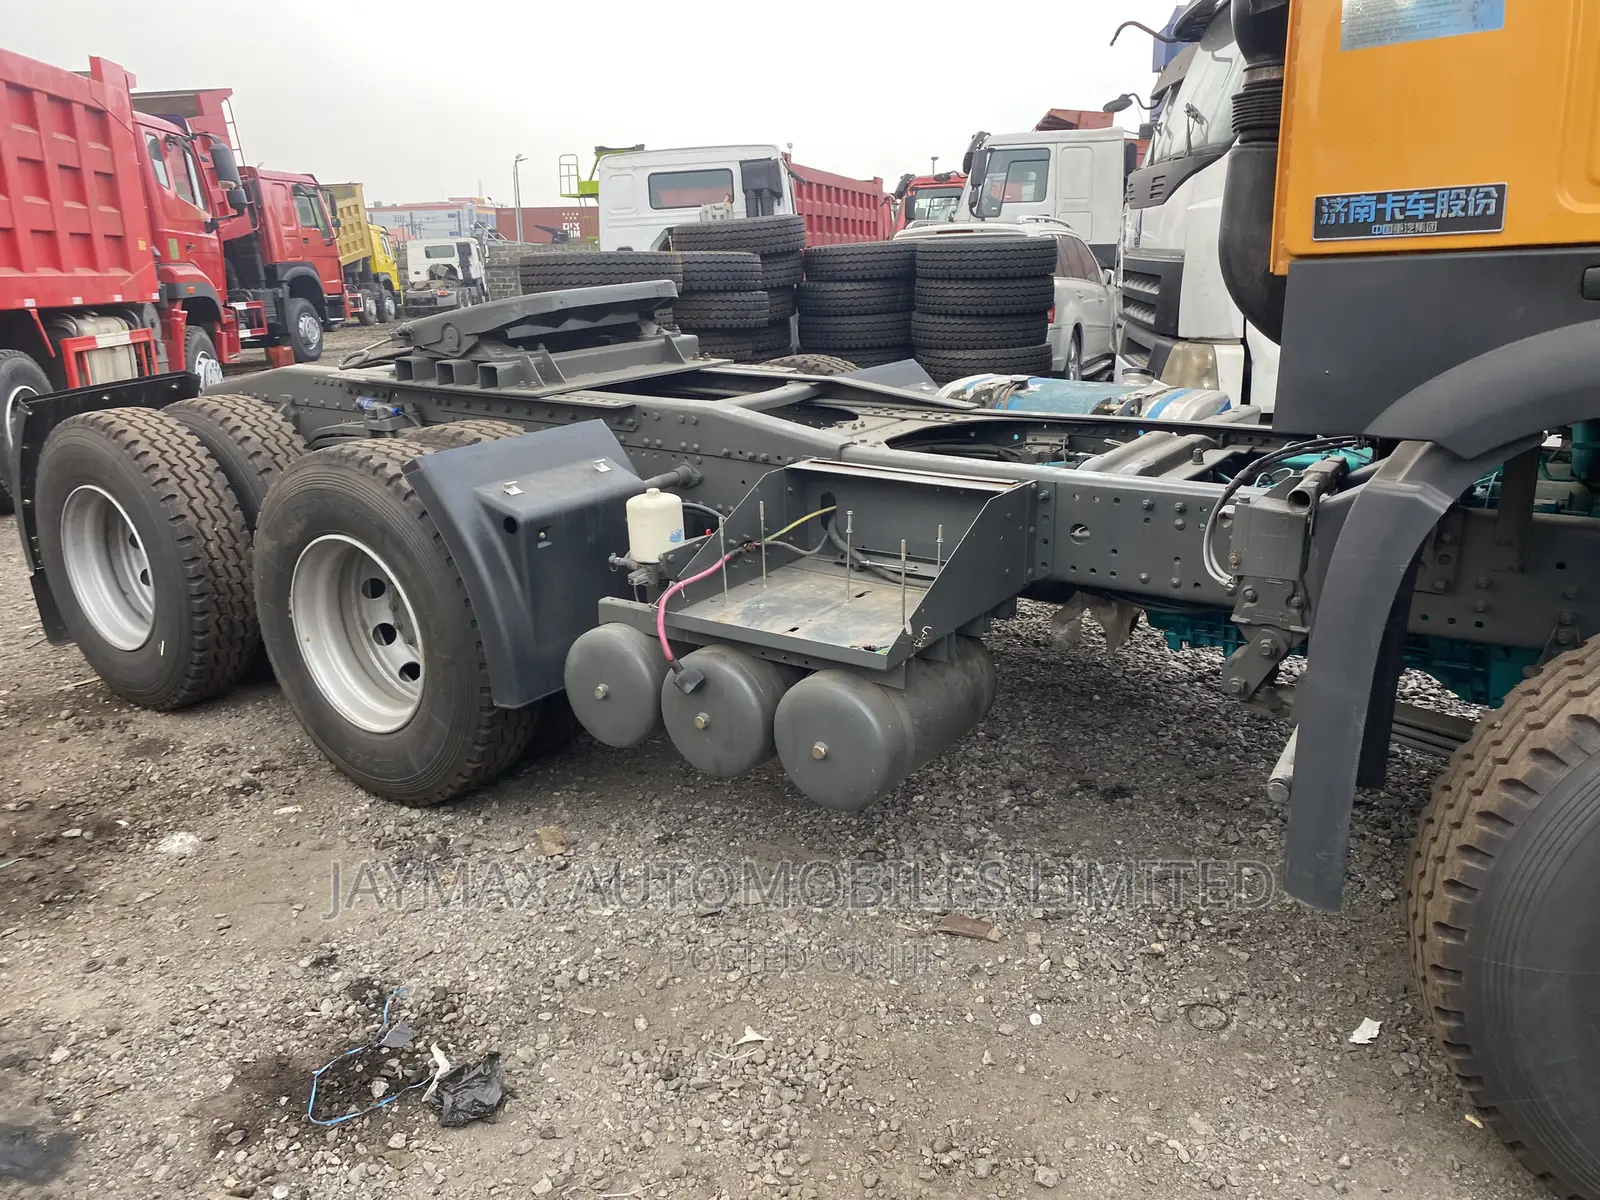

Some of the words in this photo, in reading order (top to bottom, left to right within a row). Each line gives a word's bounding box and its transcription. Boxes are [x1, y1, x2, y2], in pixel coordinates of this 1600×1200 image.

[1320, 187, 1498, 225] 济南卡车股份
